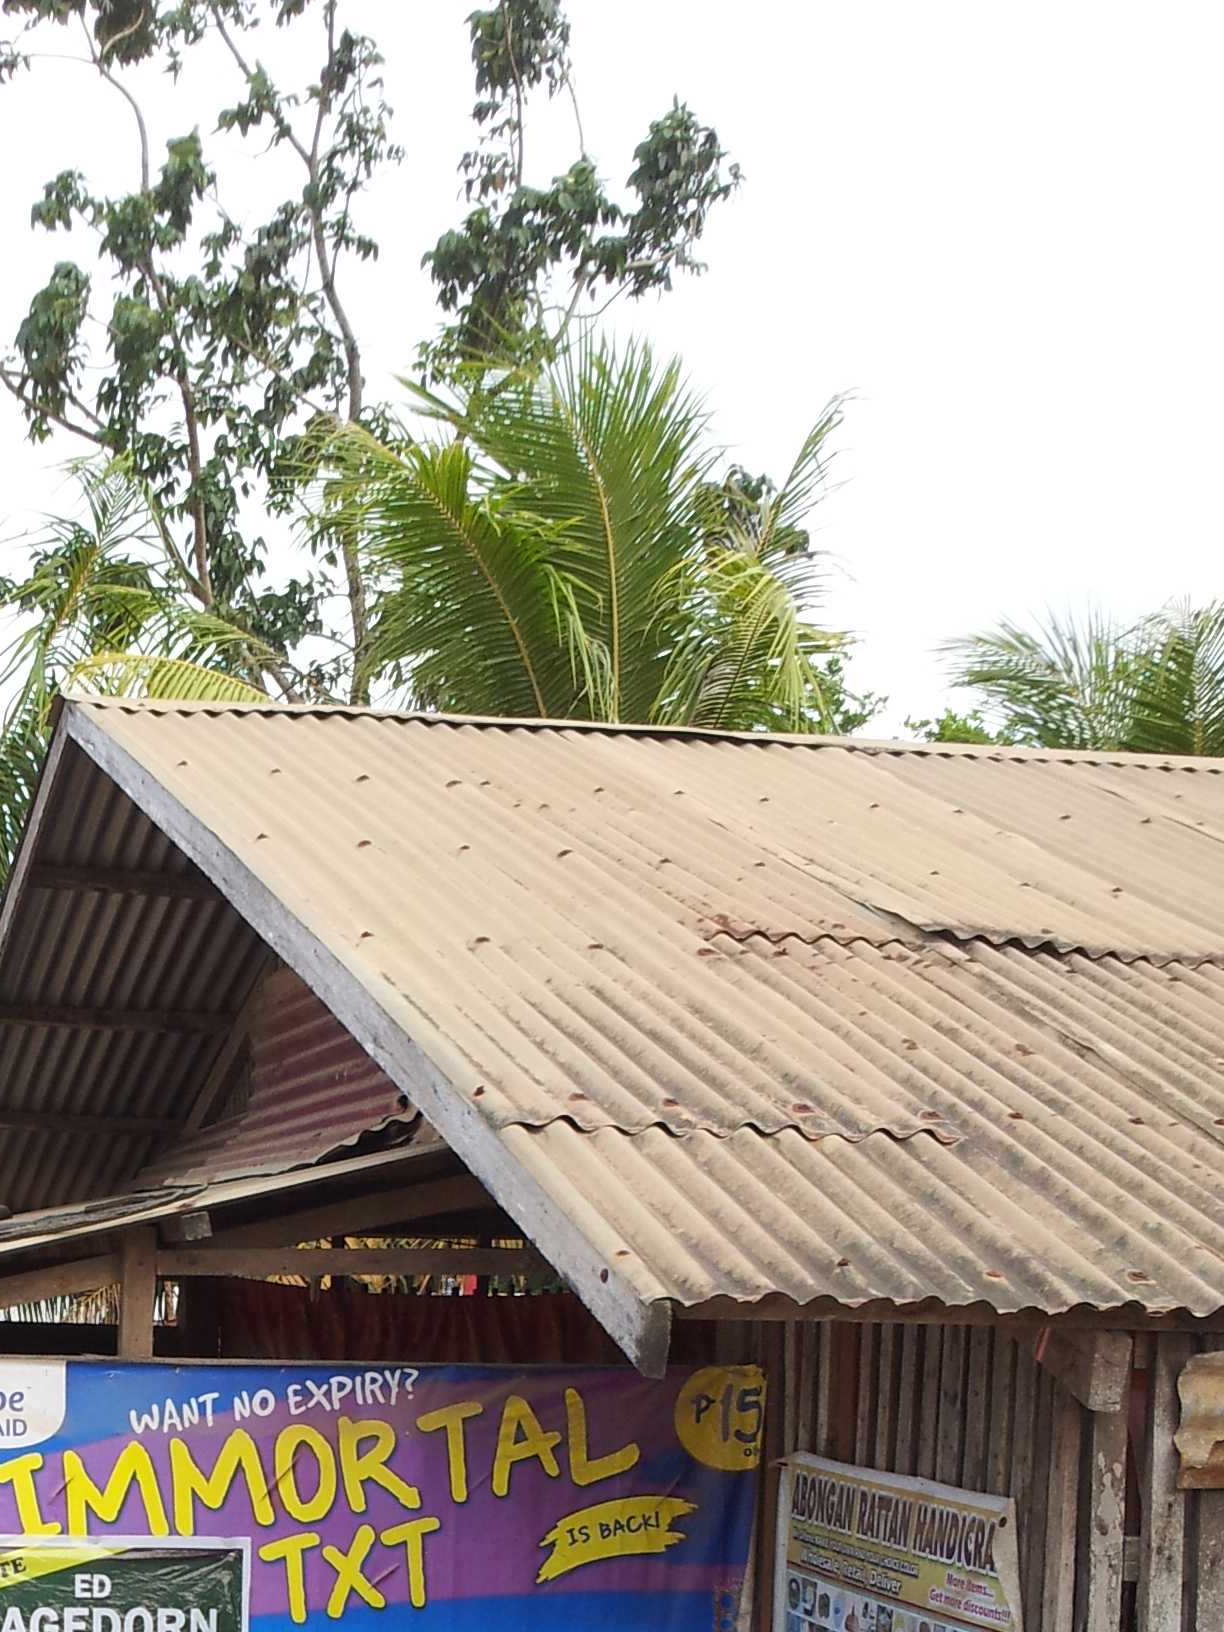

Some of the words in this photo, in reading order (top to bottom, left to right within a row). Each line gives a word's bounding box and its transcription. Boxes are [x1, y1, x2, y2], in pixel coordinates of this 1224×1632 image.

[129, 1392, 219, 1434] WANT
[233, 1389, 275, 1421] NO
[287, 1368, 419, 1416] EXPIRY?
[791, 1470, 856, 1536] ABONGAN
[856, 1485, 915, 1553] RATTAN
[565, 1525, 591, 1547] IS
[598, 1511, 661, 1540] BACK!
[259, 1515, 440, 1625] TXT
[869, 1568, 901, 1592] Deliver
[946, 1572, 965, 1590] More
[73, 1573, 112, 1599] ED
[929, 1588, 943, 1603] Get
[943, 1594, 962, 1610] more
